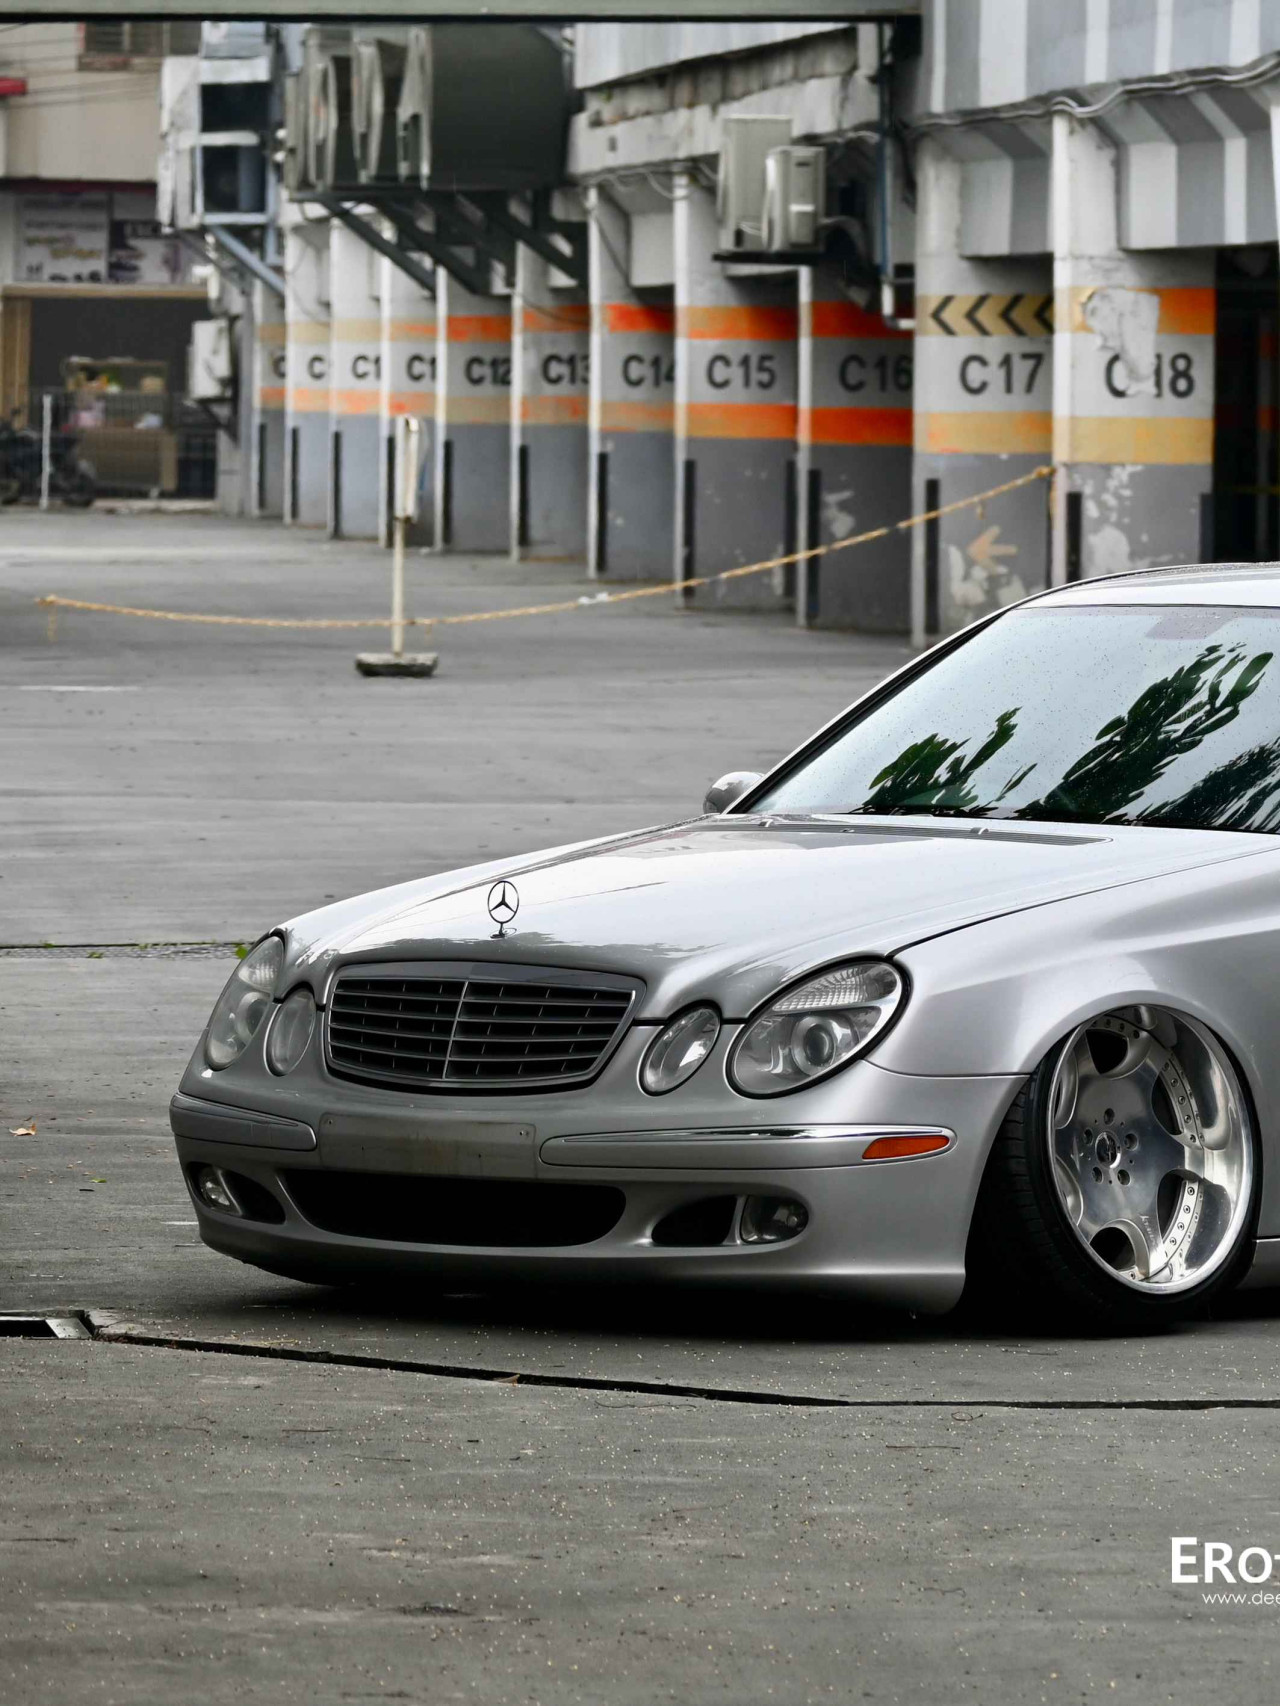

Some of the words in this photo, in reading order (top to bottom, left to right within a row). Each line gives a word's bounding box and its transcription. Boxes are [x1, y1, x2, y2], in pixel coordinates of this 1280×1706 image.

[272, 355, 286, 379] C
[307, 354, 326, 379] C
[351, 354, 381, 379] C1
[406, 353, 436, 382] C1
[706, 353, 776, 389] C15
[838, 353, 913, 393] C16
[959, 352, 1045, 395] C17
[1105, 352, 1195, 398] C18
